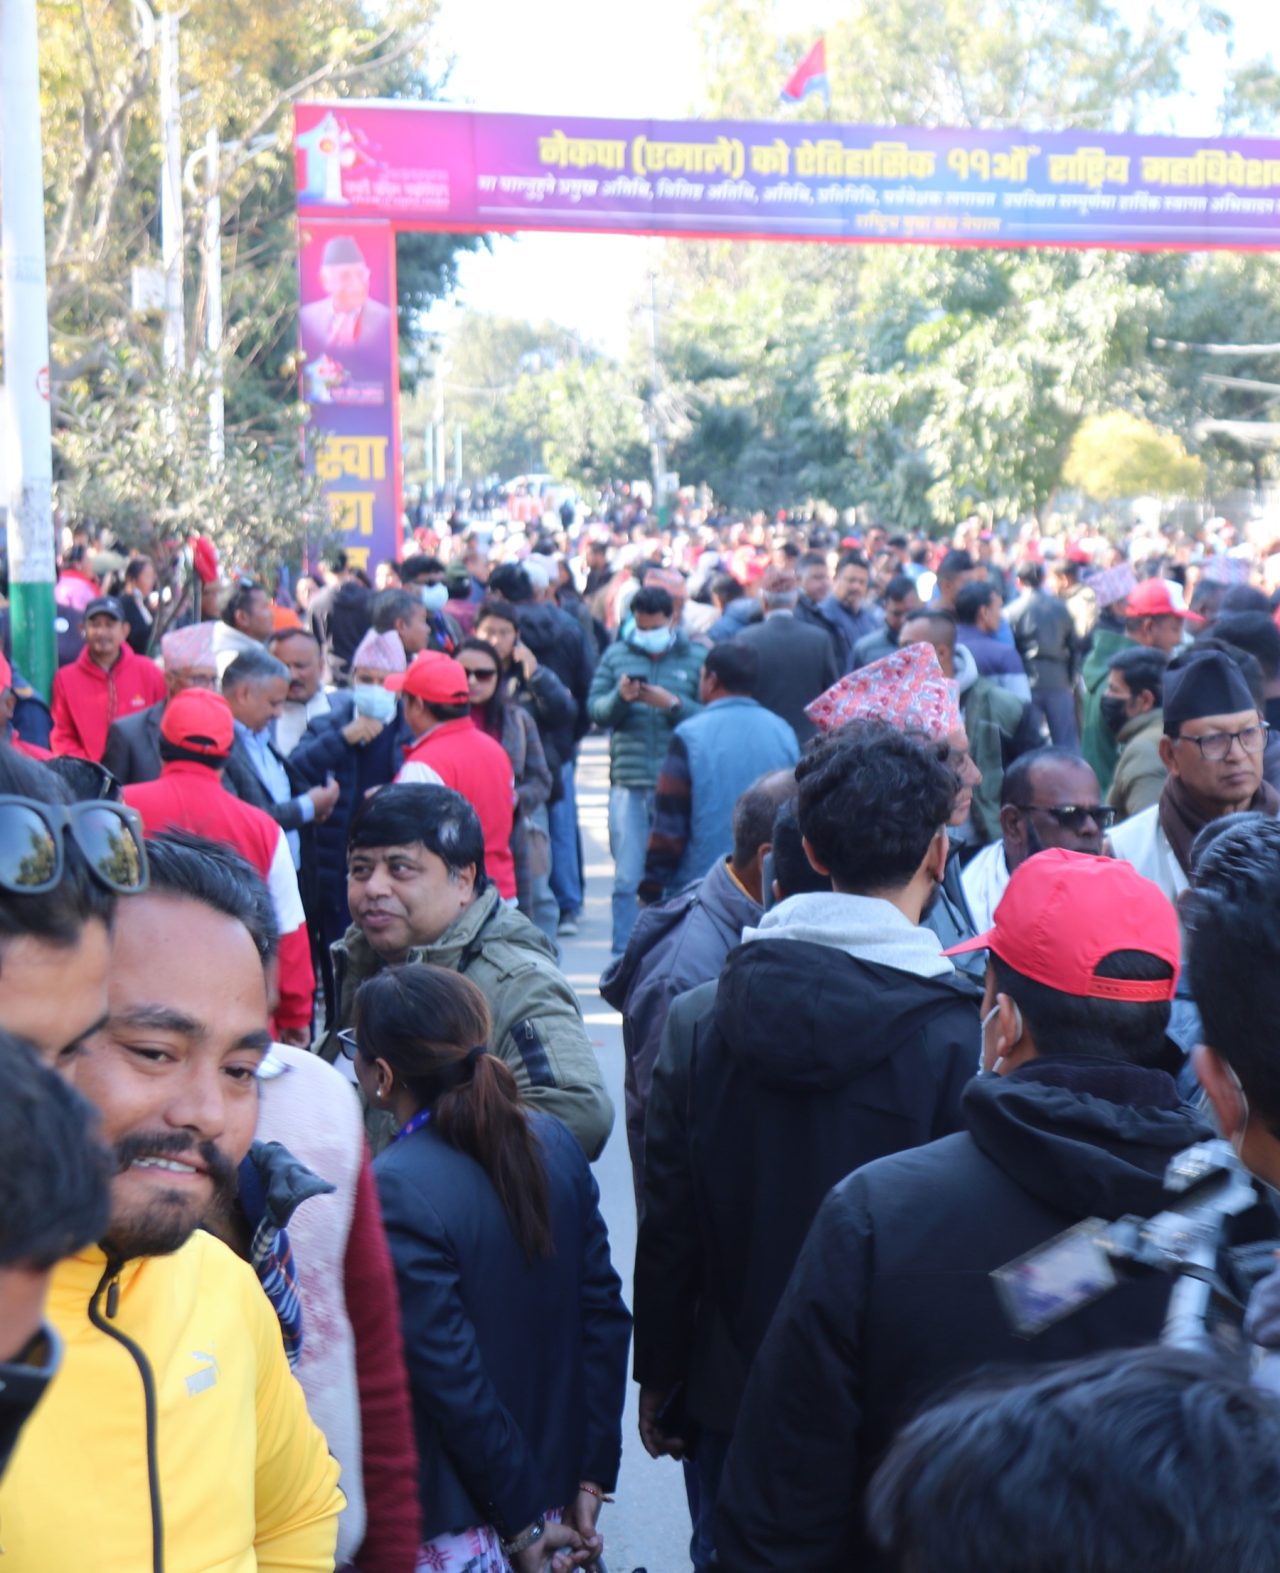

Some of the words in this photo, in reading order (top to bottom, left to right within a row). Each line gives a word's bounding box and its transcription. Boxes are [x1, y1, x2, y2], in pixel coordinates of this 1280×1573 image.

[538, 129, 626, 169] नेकपा
[632, 134, 745, 179] (एमाले)
[751, 138, 789, 175] को
[795, 138, 937, 179] ऐतिहासिक
